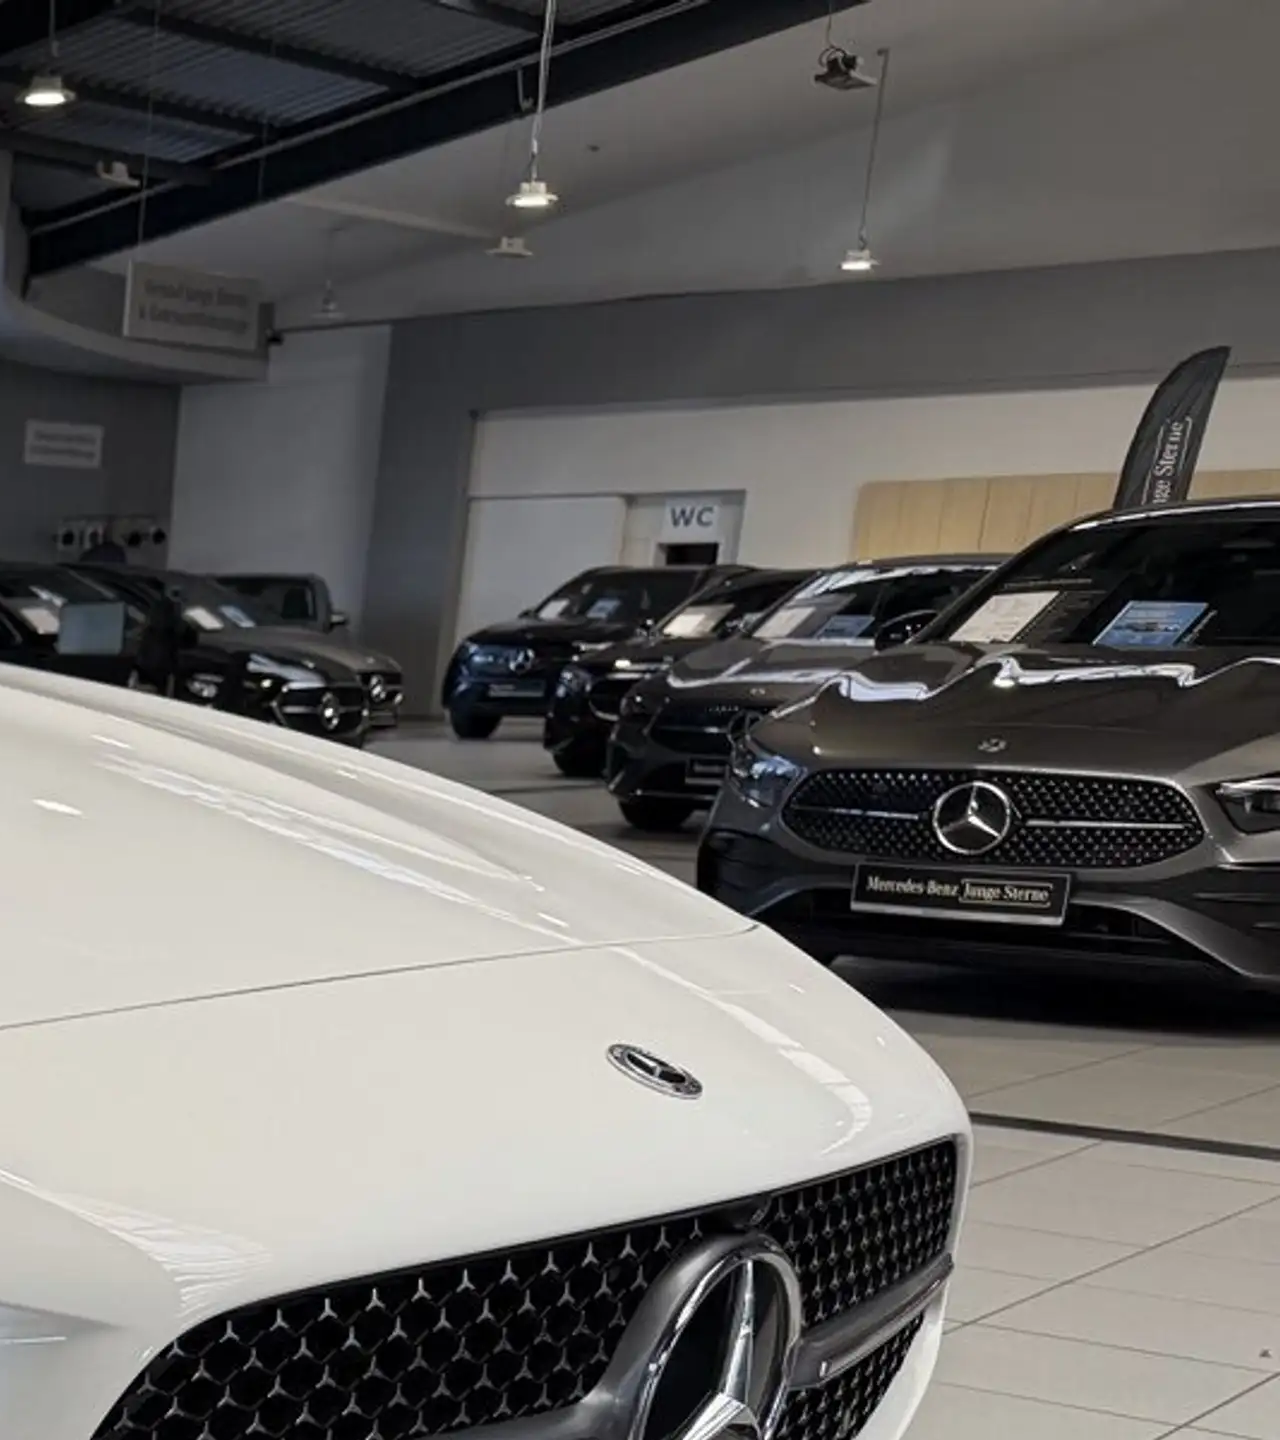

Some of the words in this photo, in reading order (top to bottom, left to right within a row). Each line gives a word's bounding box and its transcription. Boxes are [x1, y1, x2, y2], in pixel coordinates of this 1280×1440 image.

[671, 507, 714, 528] WC
[866, 875, 960, 897] Mercedes-Benz
[1004, 885, 1049, 902] Sterne
